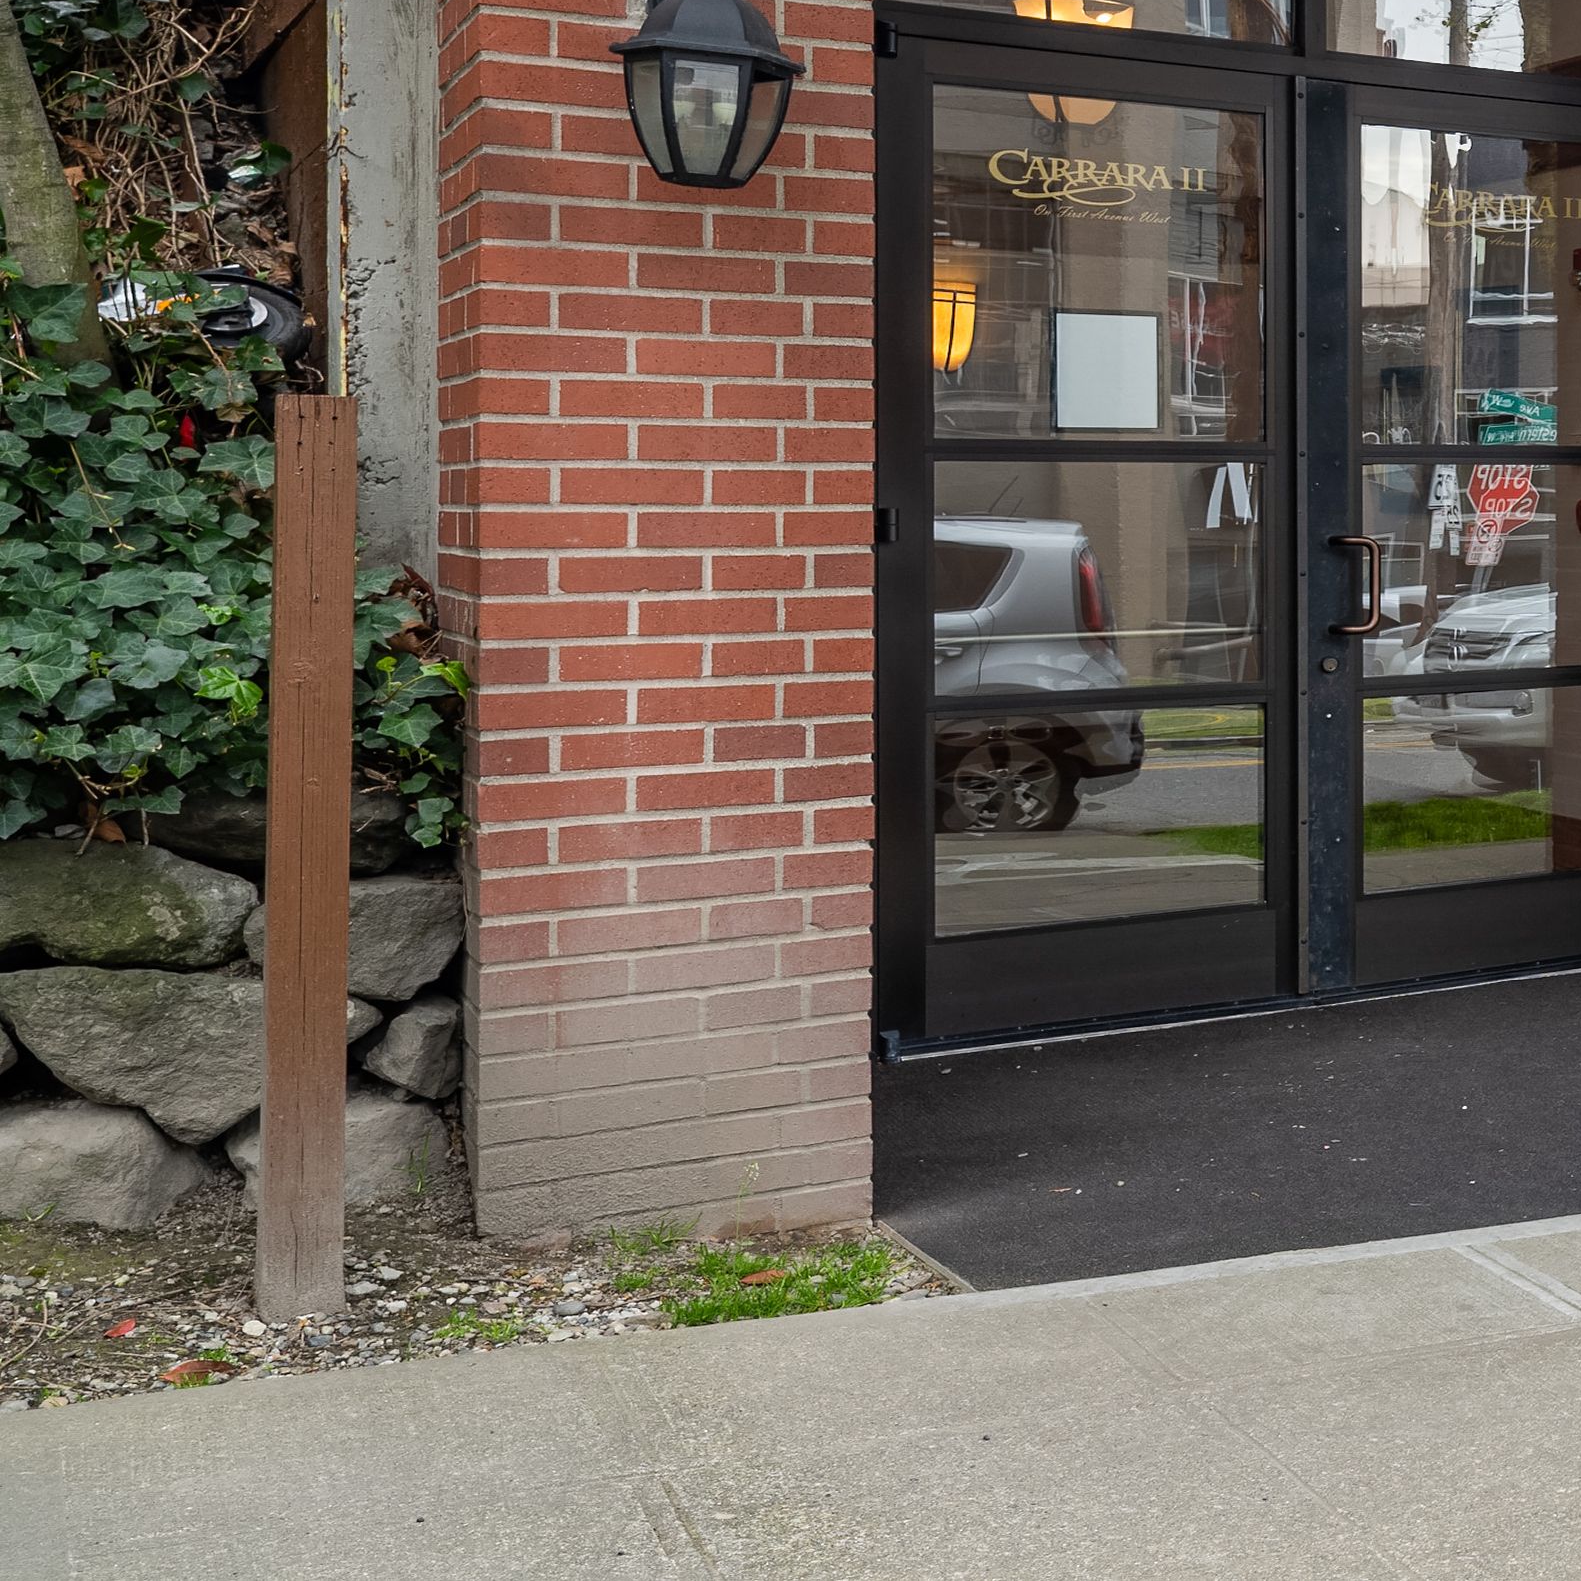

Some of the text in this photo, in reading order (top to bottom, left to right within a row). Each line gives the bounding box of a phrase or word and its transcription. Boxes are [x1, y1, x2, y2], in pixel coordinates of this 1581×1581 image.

[988, 148, 1207, 206] CARRARA II
[1033, 203, 1172, 224] On First Avenue West
